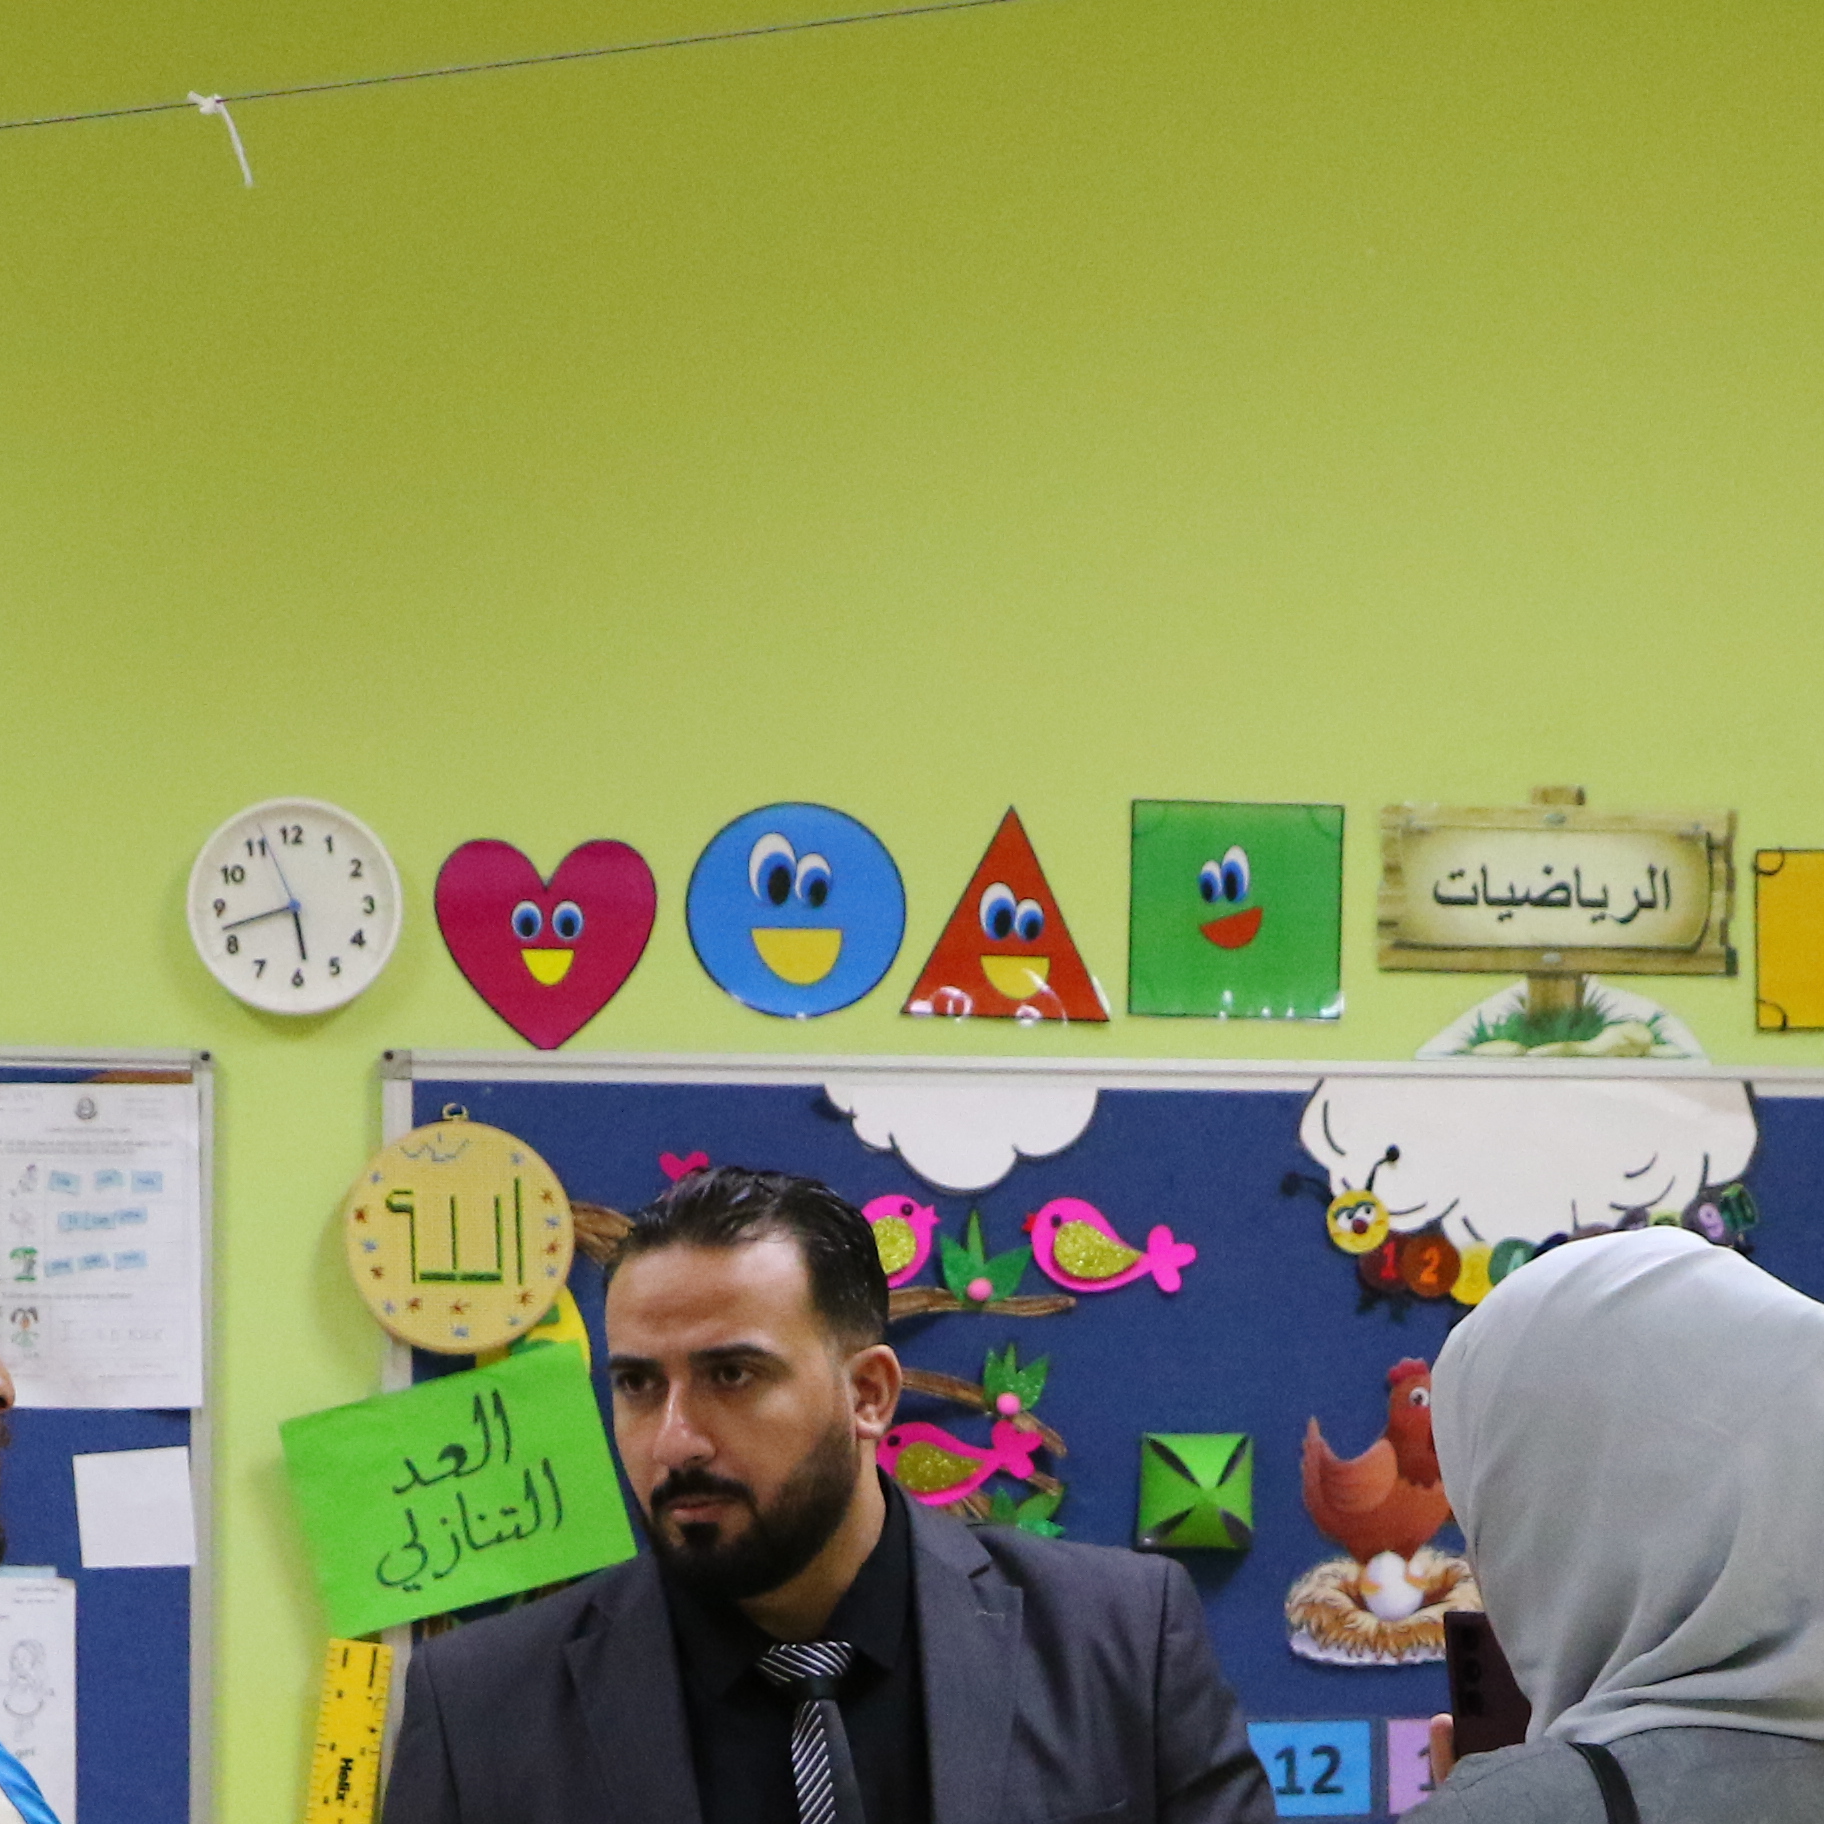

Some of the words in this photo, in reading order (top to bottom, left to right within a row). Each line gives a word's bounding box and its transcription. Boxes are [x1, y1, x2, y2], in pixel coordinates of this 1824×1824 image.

[280, 825, 303, 845] 12
[324, 835, 333, 853] 1
[246, 838, 267, 857] 11
[221, 865, 245, 884] 10
[349, 858, 363, 878] 2
[1432, 863, 1673, 924] الرياضيات
[213, 898, 226, 917] 9
[363, 895, 375, 914] 3
[227, 935, 239, 954] 8
[350, 929, 366, 947] 4
[253, 959, 266, 978] 7
[328, 957, 341, 976] 5
[291, 968, 304, 987] 6
[1698, 1203, 1725, 1238] 9
[1380, 1241, 1398, 1279] 1
[1419, 1246, 1441, 1284] 2
[392, 1388, 512, 1494] العد
[376, 1458, 564, 1592] التنازلي
[336, 1757, 354, 1801] Helix
[1274, 1744, 1344, 1795] 12
